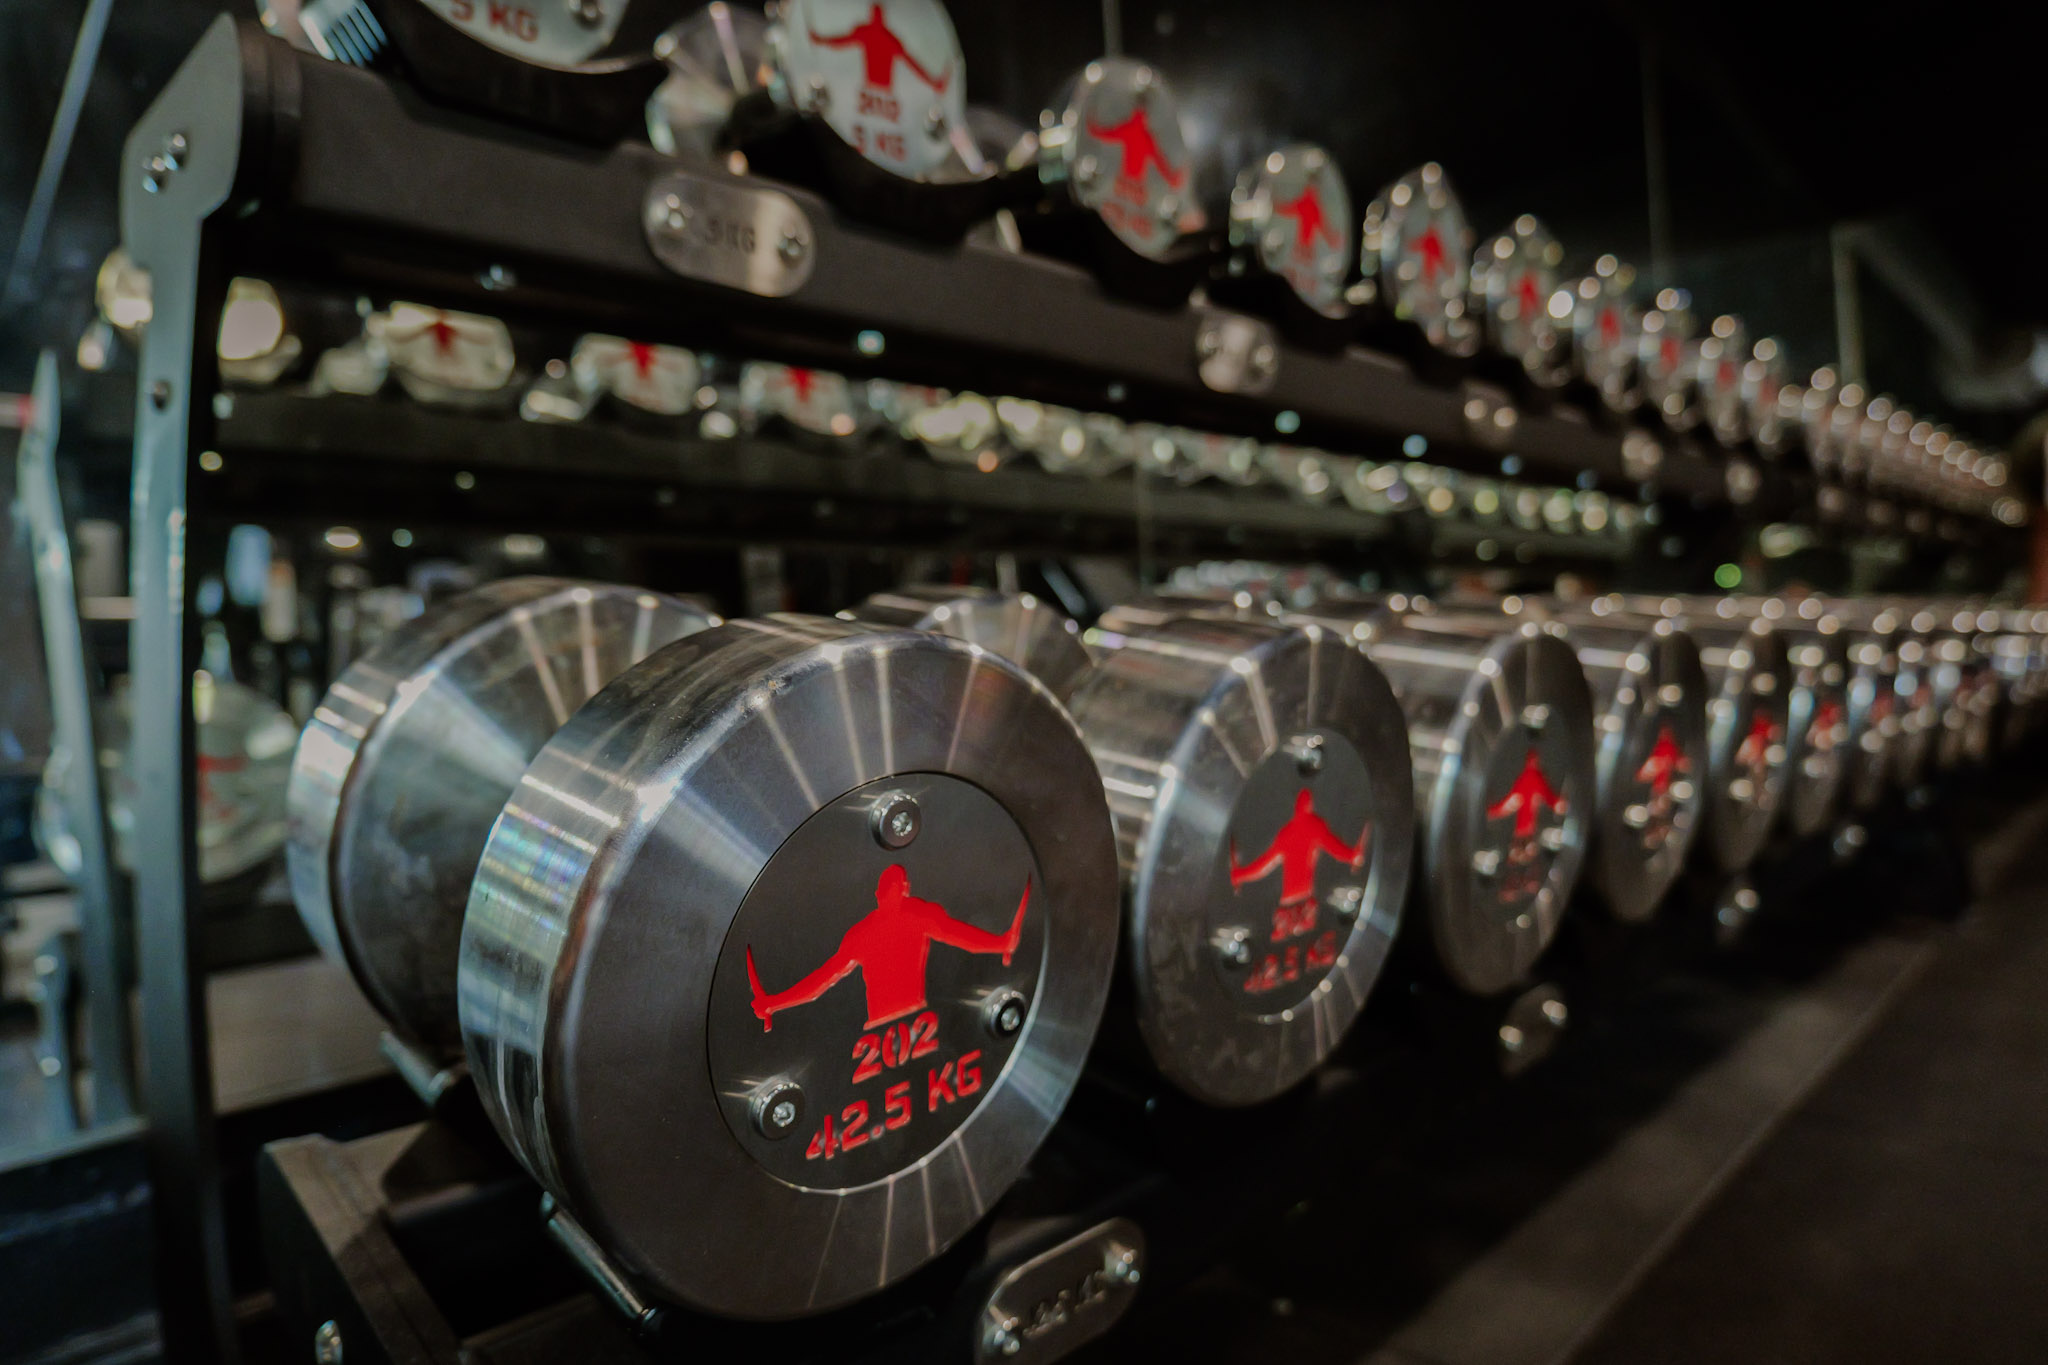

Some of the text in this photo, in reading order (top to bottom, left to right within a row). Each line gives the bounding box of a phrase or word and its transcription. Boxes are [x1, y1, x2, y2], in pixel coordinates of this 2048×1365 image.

[486, 0, 540, 43] KG
[852, 1010, 939, 1085] 202
[805, 1048, 983, 1161] 42.5 KG
